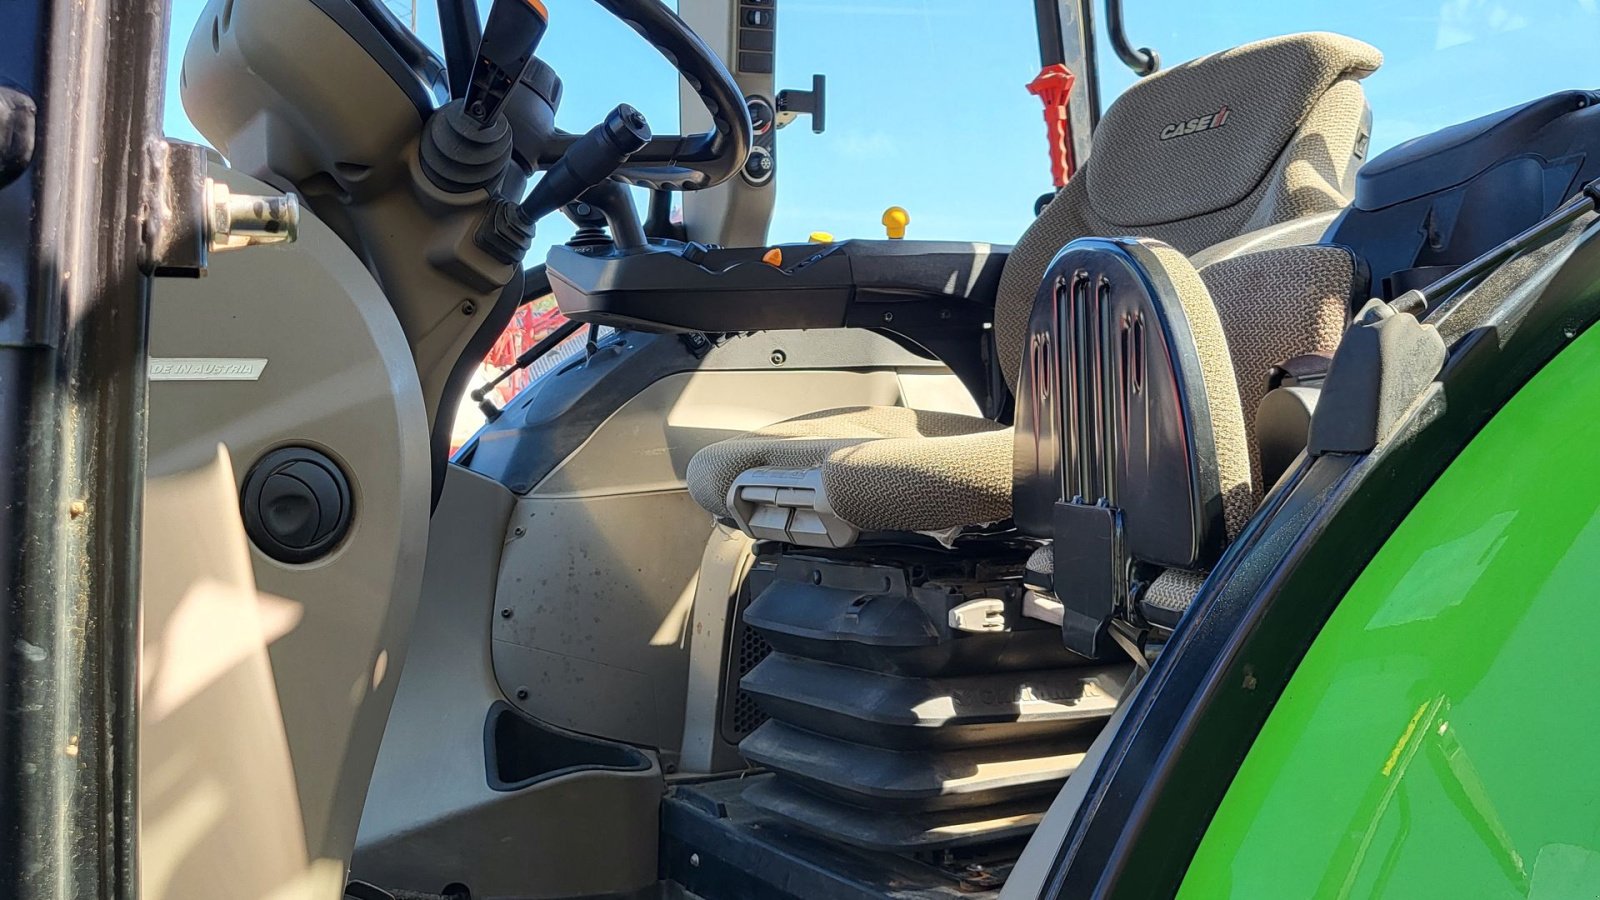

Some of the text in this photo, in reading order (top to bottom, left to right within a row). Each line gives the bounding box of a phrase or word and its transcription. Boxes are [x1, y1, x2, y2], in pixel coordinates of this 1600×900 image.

[150, 363, 254, 375] DE IN AUSTRIA
